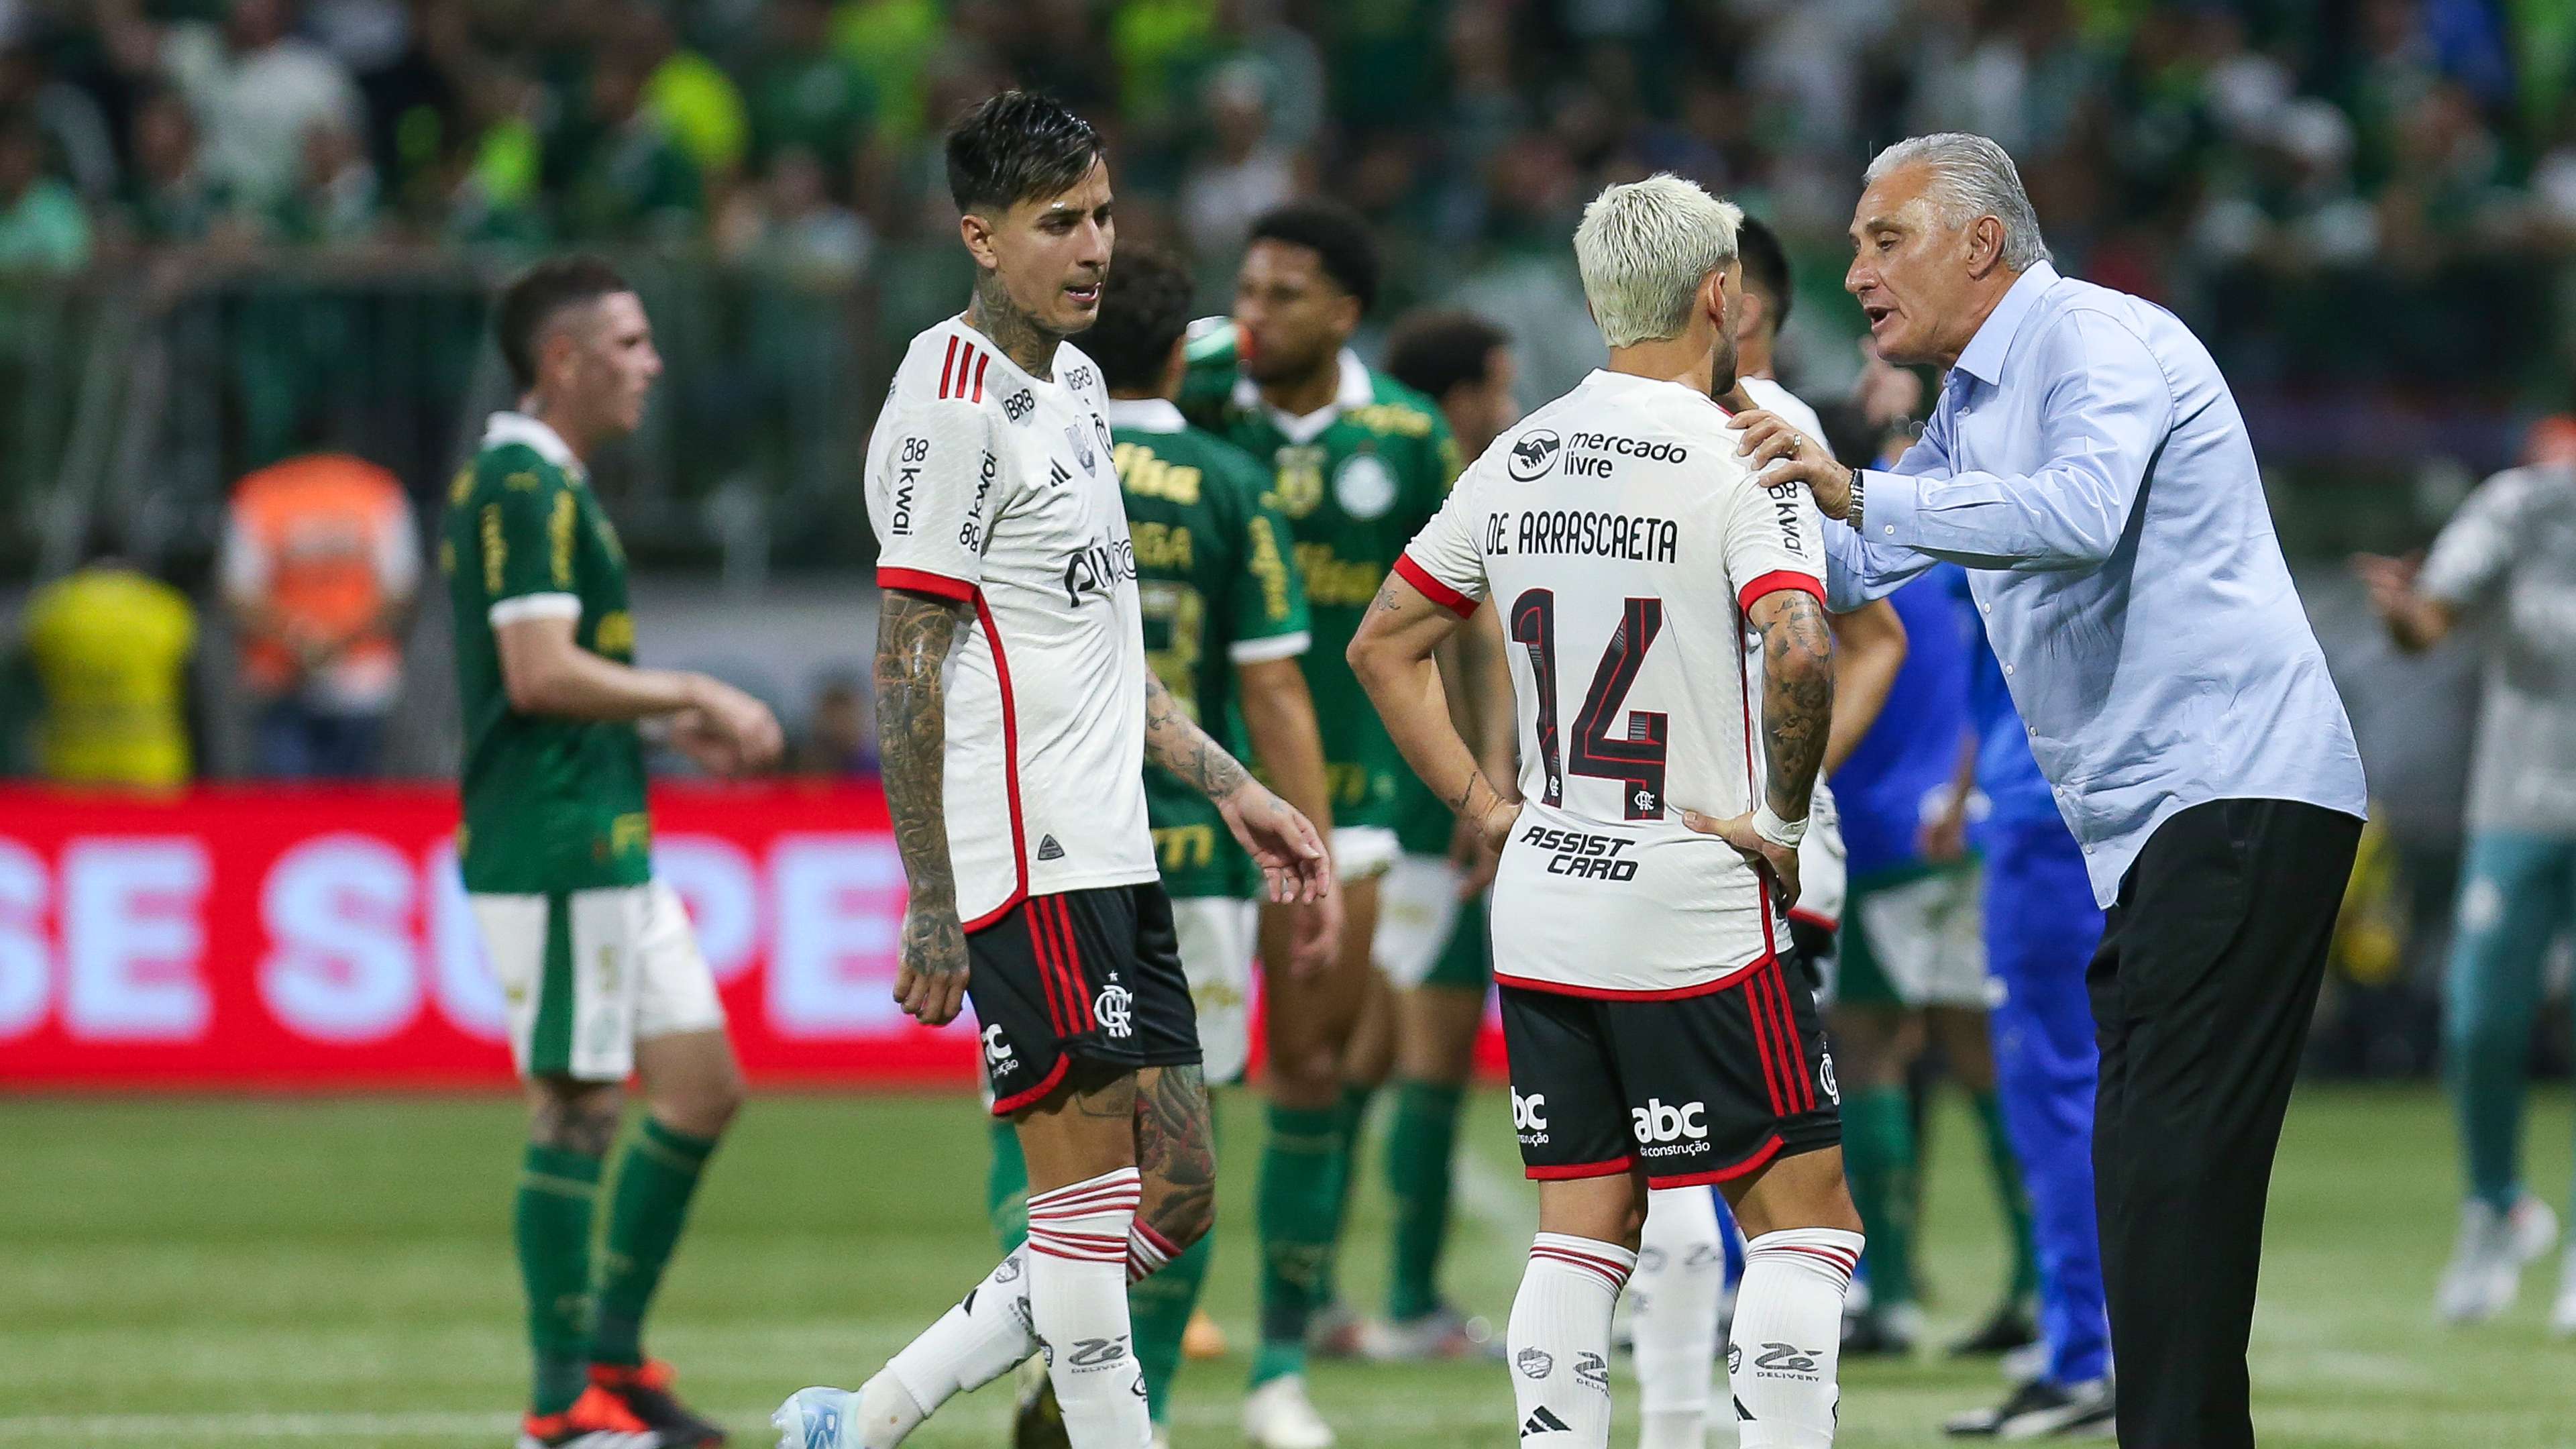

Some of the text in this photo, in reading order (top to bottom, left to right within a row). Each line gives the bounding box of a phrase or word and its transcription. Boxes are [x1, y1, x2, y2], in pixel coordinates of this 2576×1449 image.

[1003, 388, 1035, 424] BRB
[1564, 451, 1613, 478] livre
[1568, 432, 1687, 464] mercado
[892, 468, 922, 536] kwai
[968, 449, 998, 520] kwai
[1487, 511, 1678, 564] DE ARRASCAETA
[1776, 502, 1809, 559] kwai
[1511, 588, 1668, 820] 14
[1519, 826, 1635, 857] ASSIST
[1547, 854, 1639, 881] CARD
[1510, 1085, 1547, 1130] bc
[1631, 1098, 1707, 1143] abc
[1648, 1140, 1711, 1157] construção
[1756, 1371, 1820, 1382] DELIVERY
